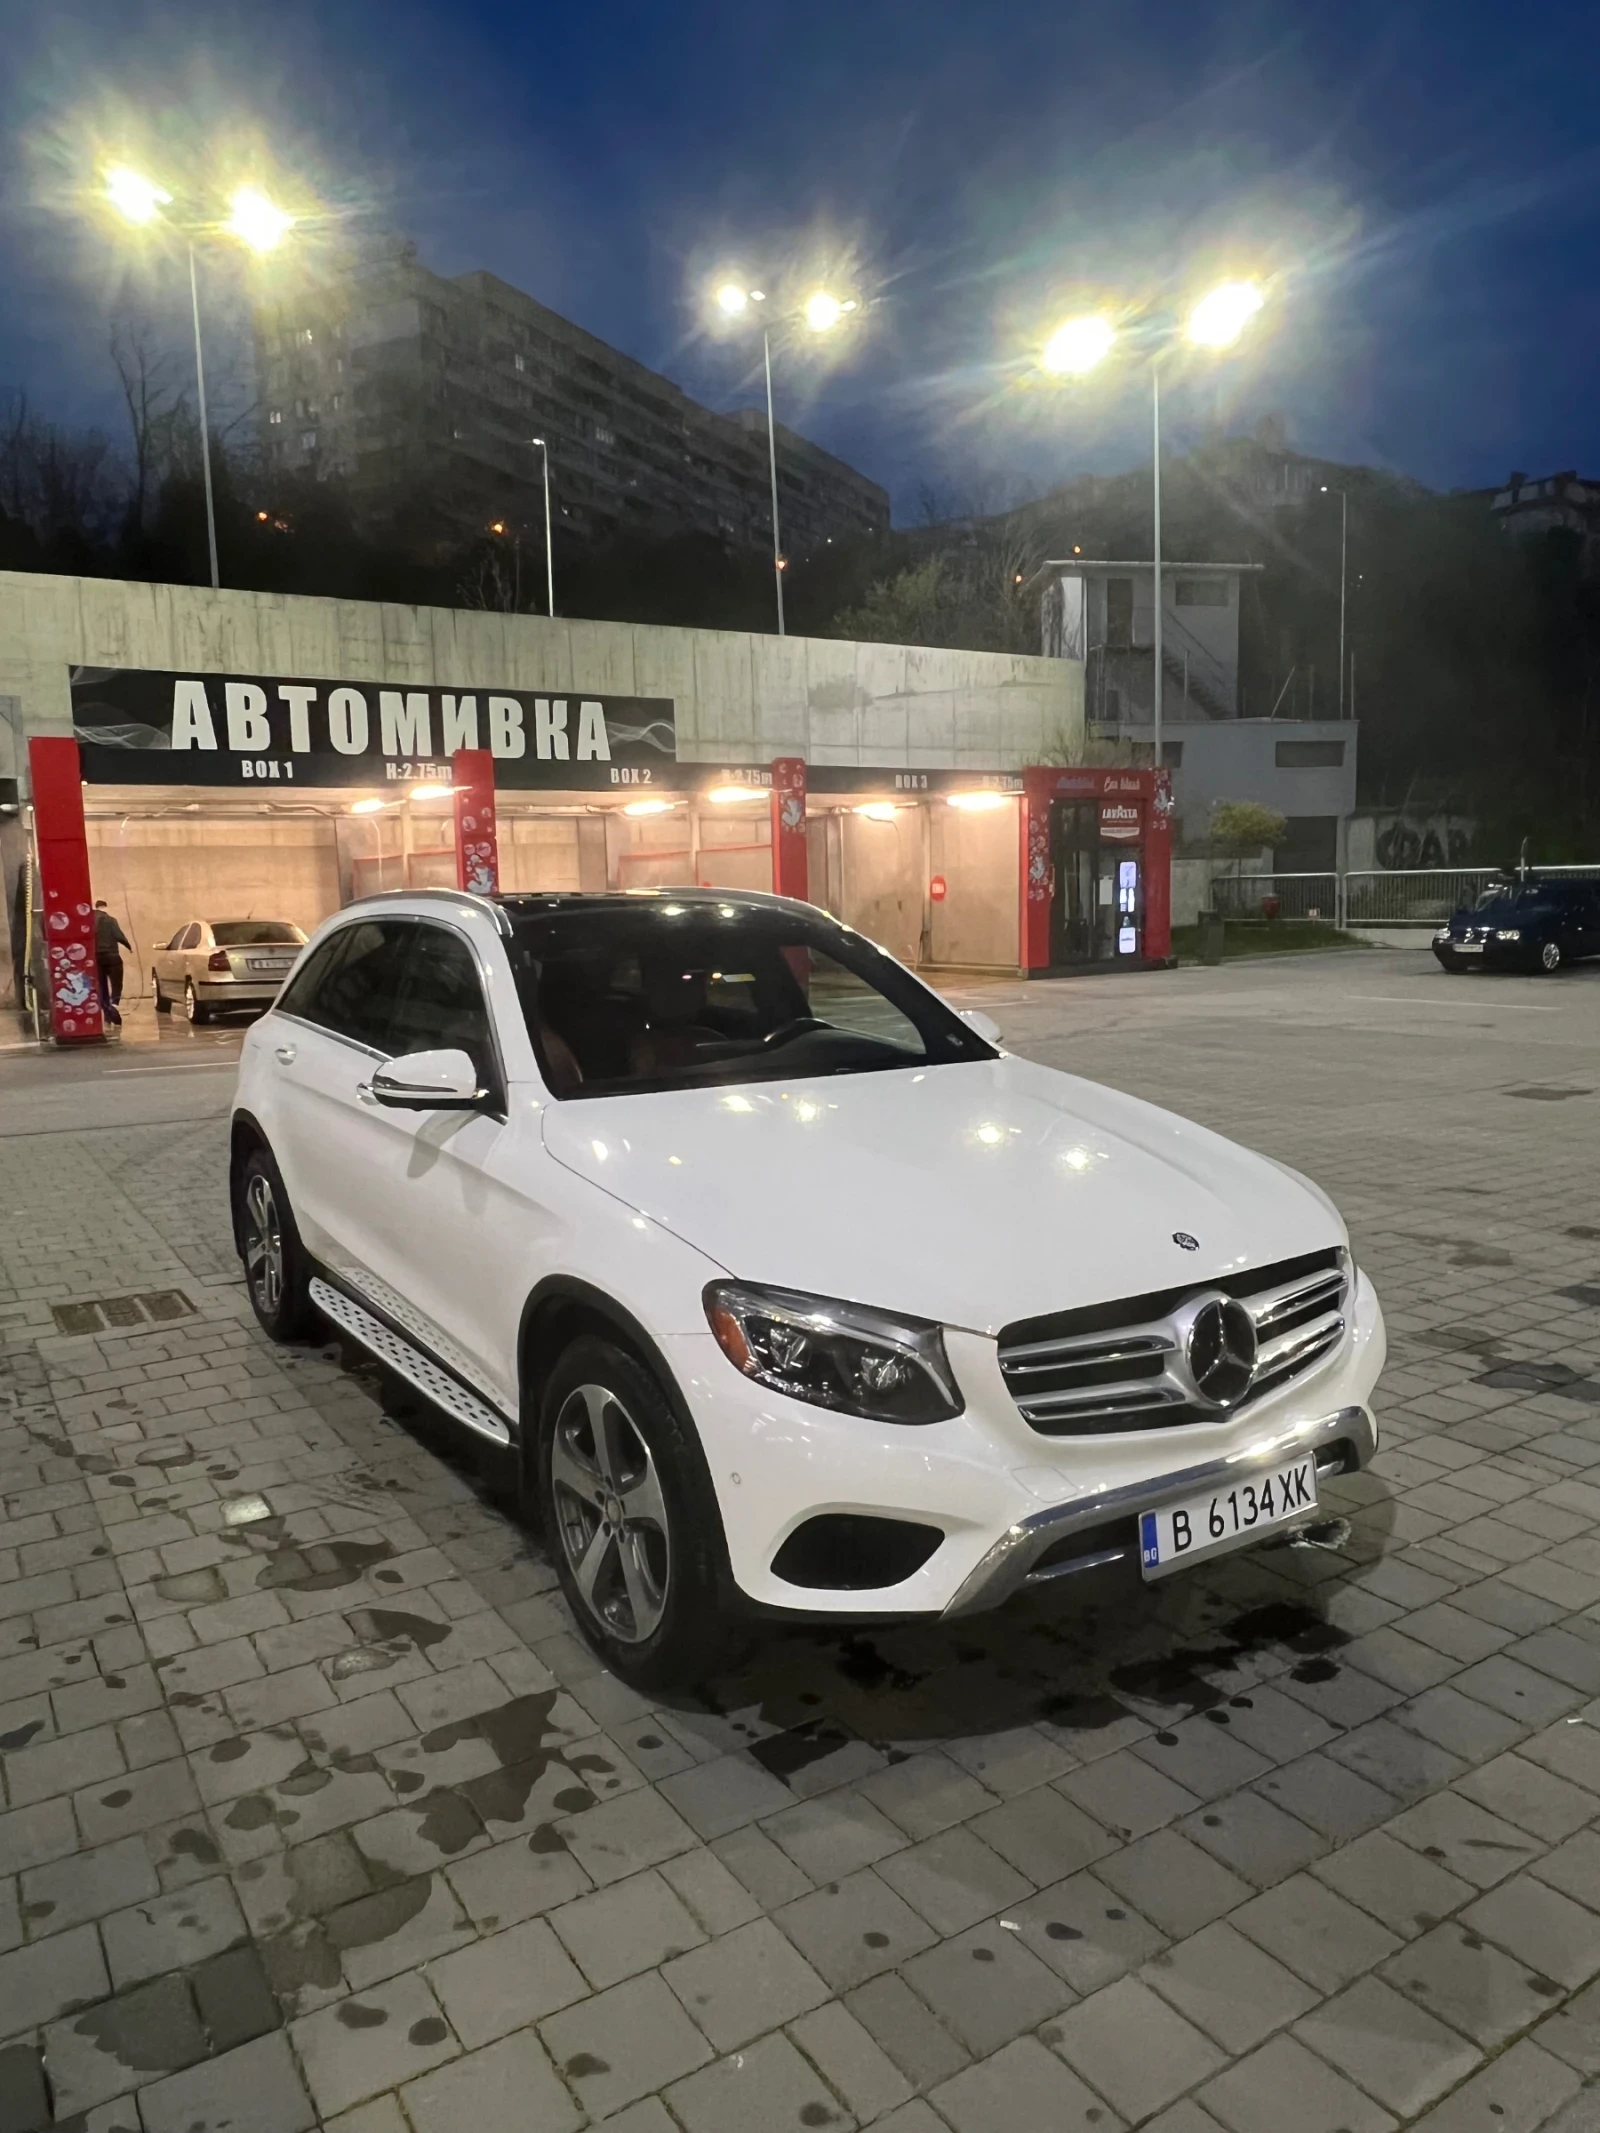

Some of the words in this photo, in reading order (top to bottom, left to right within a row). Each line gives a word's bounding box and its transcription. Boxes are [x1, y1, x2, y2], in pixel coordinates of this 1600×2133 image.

[171, 680, 611, 761] АВТОМИВКА
[241, 760, 281, 778] BOX
[283, 761, 293, 778] 1
[610, 768, 640, 784] BOX
[642, 769, 652, 784] 2
[1172, 1510, 1192, 1553] B
[1143, 1547, 1158, 1563] BG
